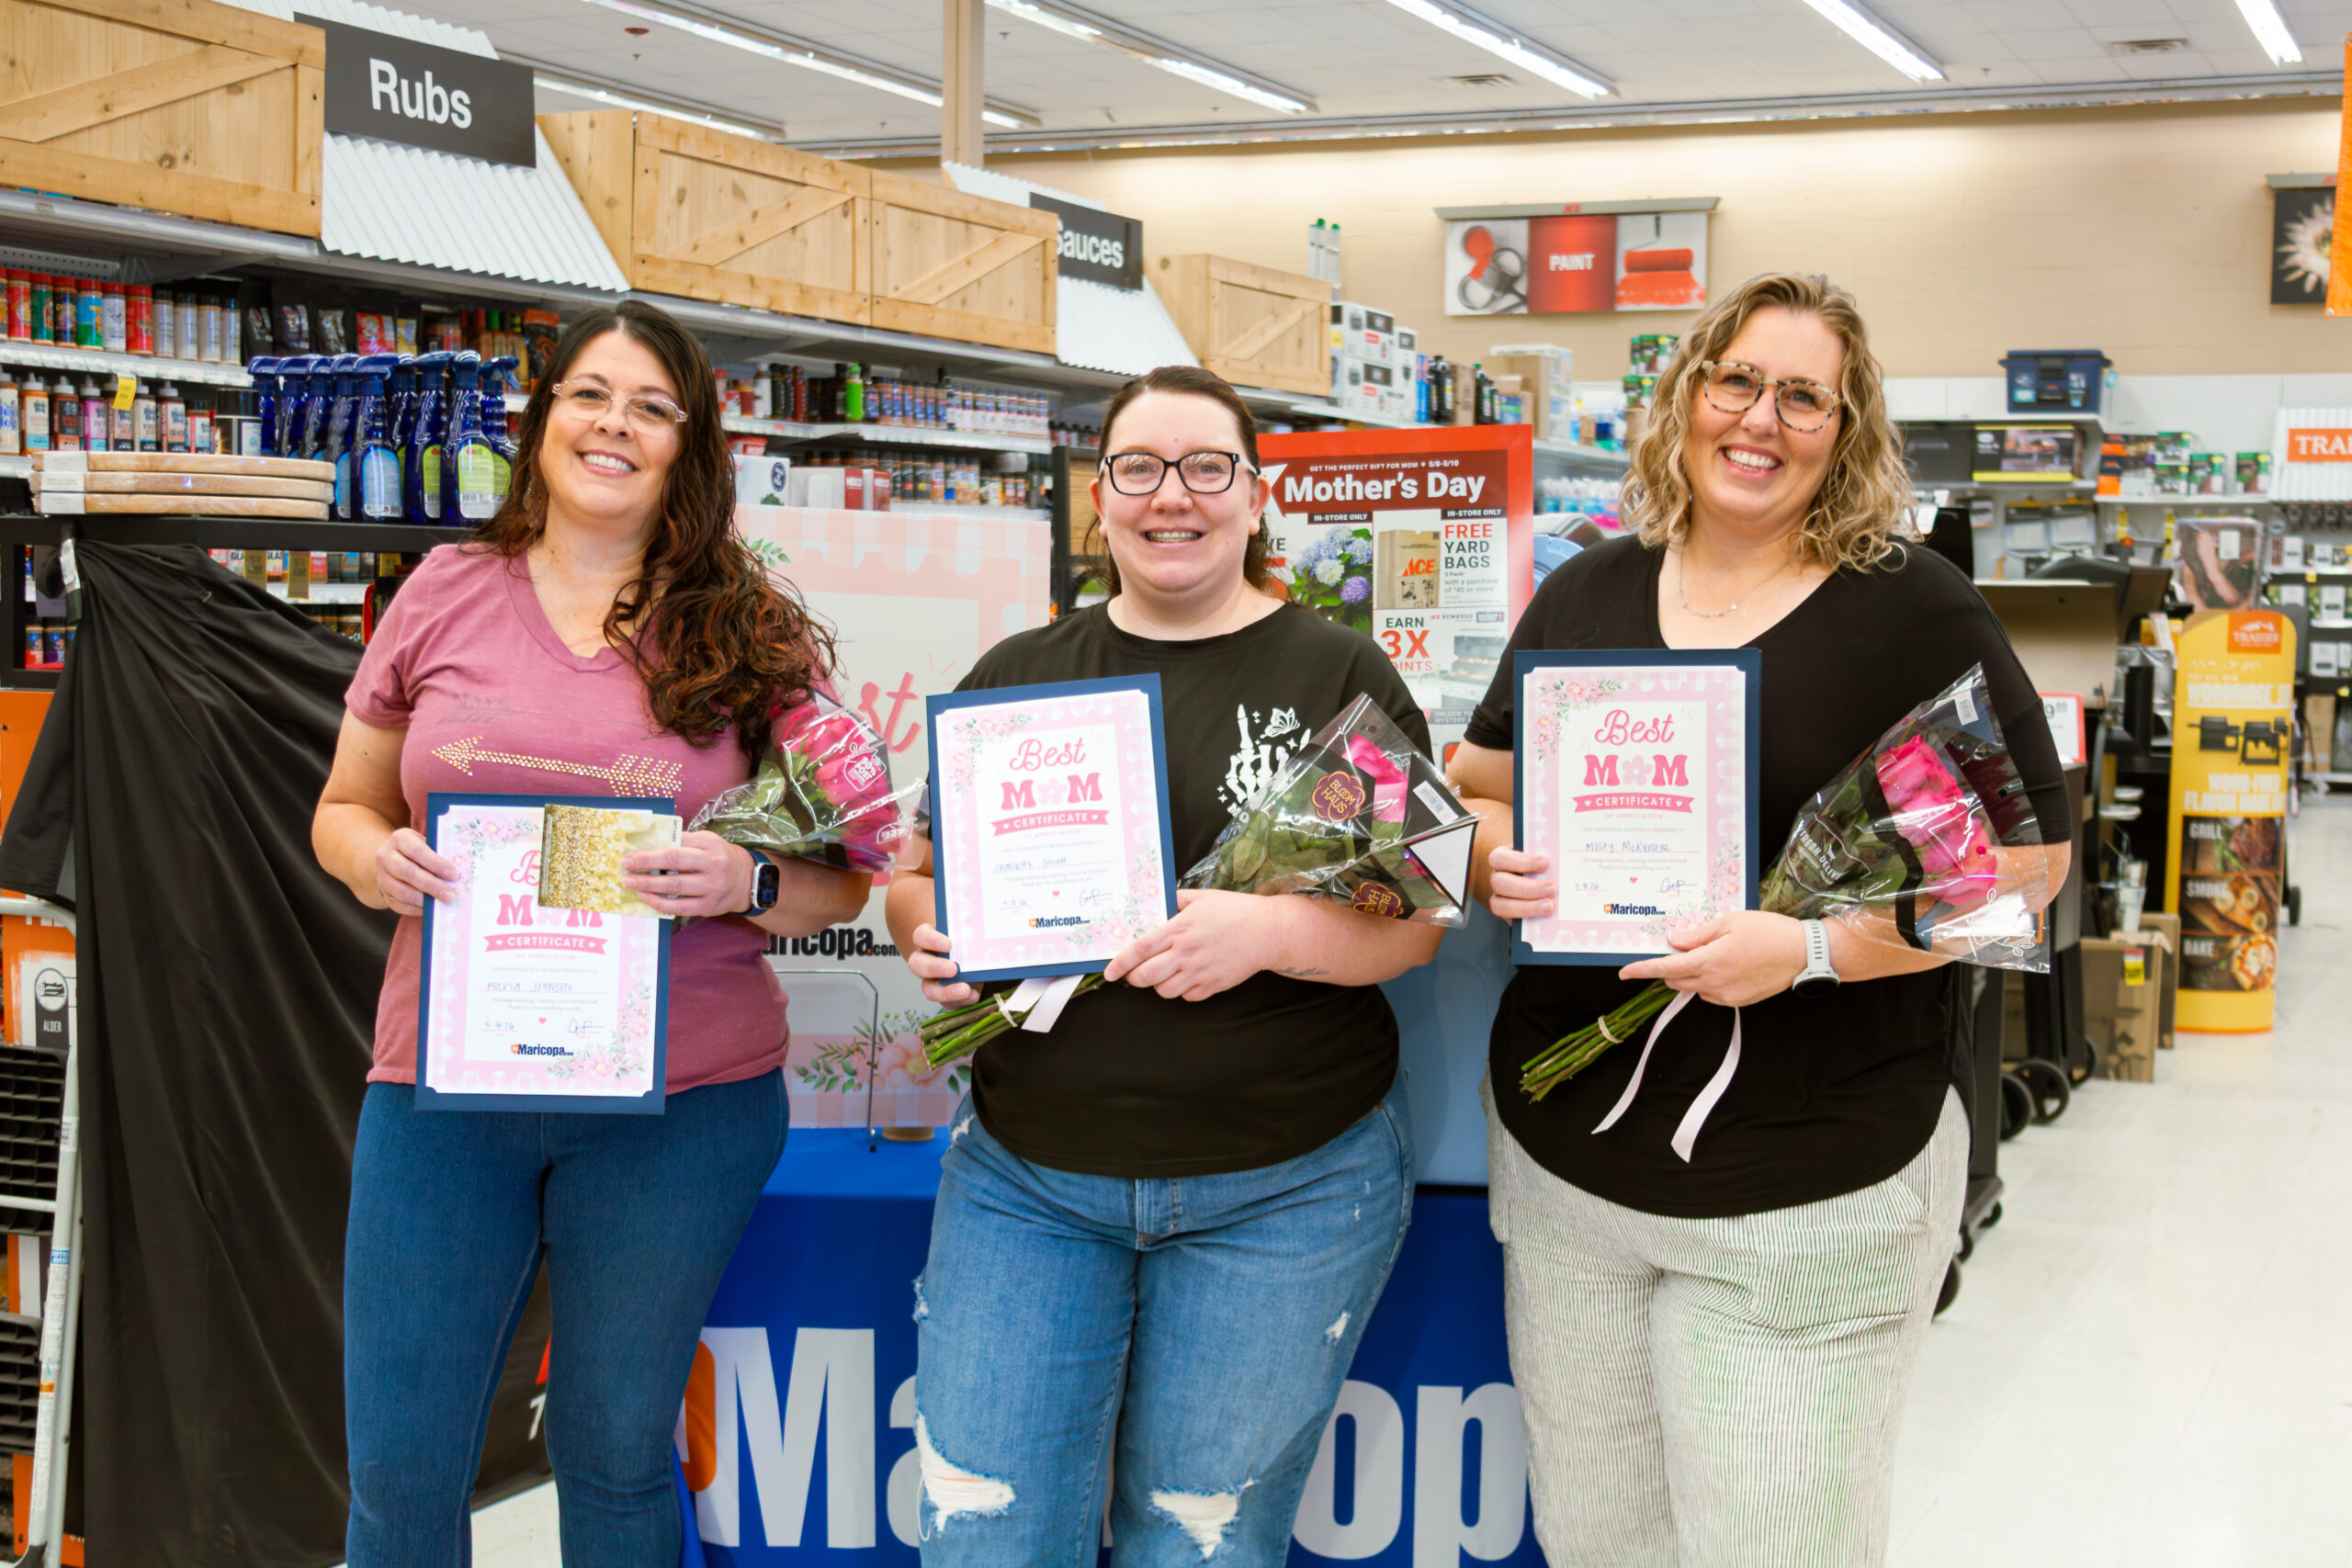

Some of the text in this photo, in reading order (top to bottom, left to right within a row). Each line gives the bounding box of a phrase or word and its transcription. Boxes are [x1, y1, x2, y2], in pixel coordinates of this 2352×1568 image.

[369, 58, 472, 129] Rubs
[1549, 254, 1595, 271] PAINT
[1284, 472, 1486, 503] Mother's Day
[1444, 523, 1493, 539] FREE
[1444, 540, 1490, 554] YARD
[1402, 558, 1436, 577] ACE
[1444, 556, 1490, 570] BAGS
[1466, 578, 1498, 587] purchase
[1385, 617, 1424, 628] EARN
[1381, 630, 1430, 659] 3X
[1595, 709, 1675, 746] Best
[1009, 738, 1087, 772] Best
[1321, 787, 1348, 814] HAUS
[1329, 779, 1356, 807] BLOOM
[1595, 796, 1671, 807] CERTIFICATE
[1013, 813, 1088, 829] CERTIFICATE
[2189, 822, 2223, 840] GRILL
[1800, 828, 1822, 855] FRESH
[2187, 881, 2228, 898] SMOKE
[507, 937, 585, 949] CERTIFICATE
[2184, 941, 2215, 956] BAKE
[43, 1020, 62, 1033] ALDER
